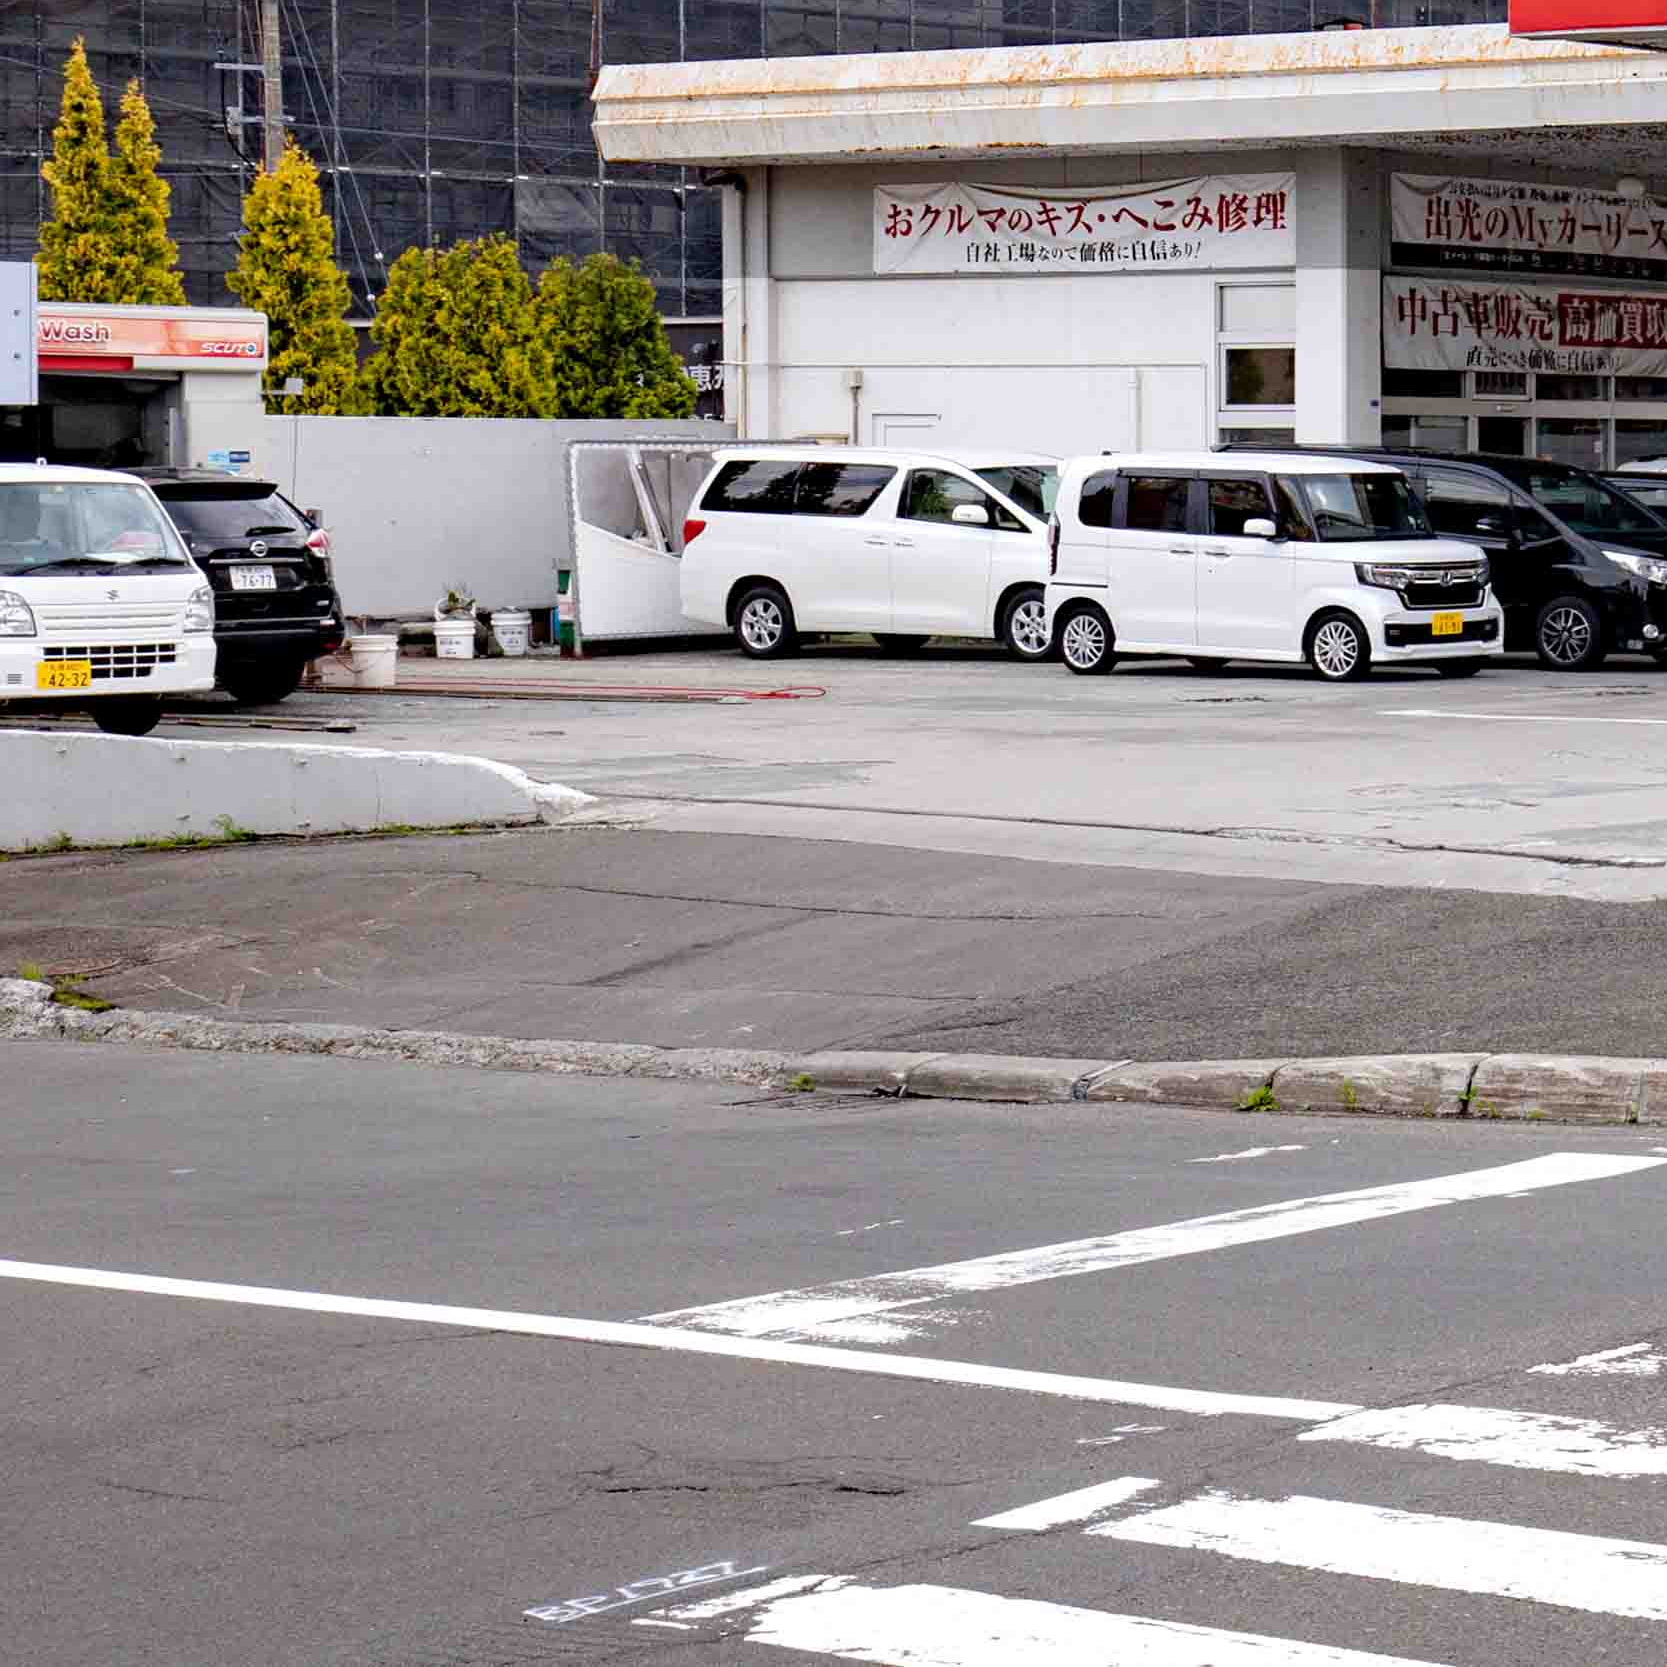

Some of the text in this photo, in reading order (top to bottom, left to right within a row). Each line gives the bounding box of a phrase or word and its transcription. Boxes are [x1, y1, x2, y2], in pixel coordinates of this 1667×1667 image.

[40, 319, 111, 343] Wash
[1396, 286, 1554, 342] 中古車販売
